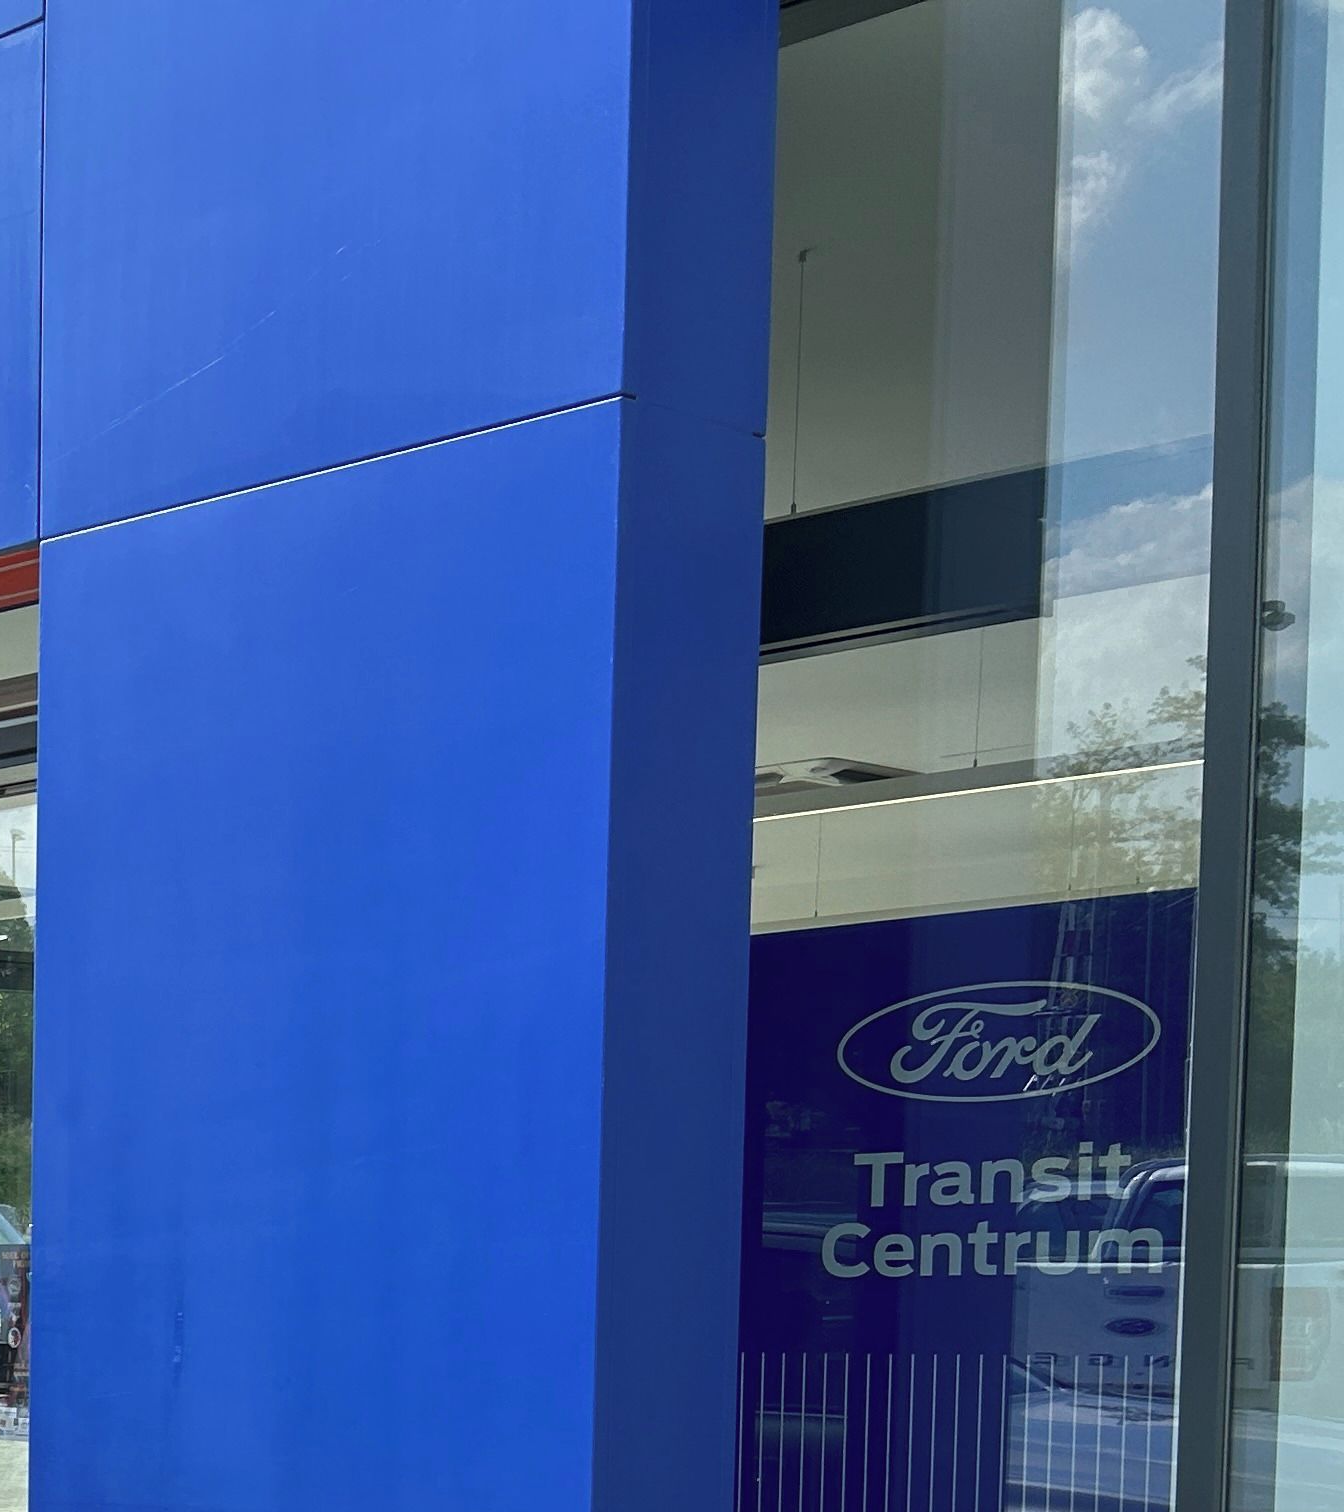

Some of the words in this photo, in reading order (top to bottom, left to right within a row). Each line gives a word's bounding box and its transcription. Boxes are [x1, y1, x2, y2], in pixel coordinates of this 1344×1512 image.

[889, 1000, 1102, 1084] Ford
[853, 1141, 1132, 1207] Transit
[821, 1221, 1164, 1278] Centrum
